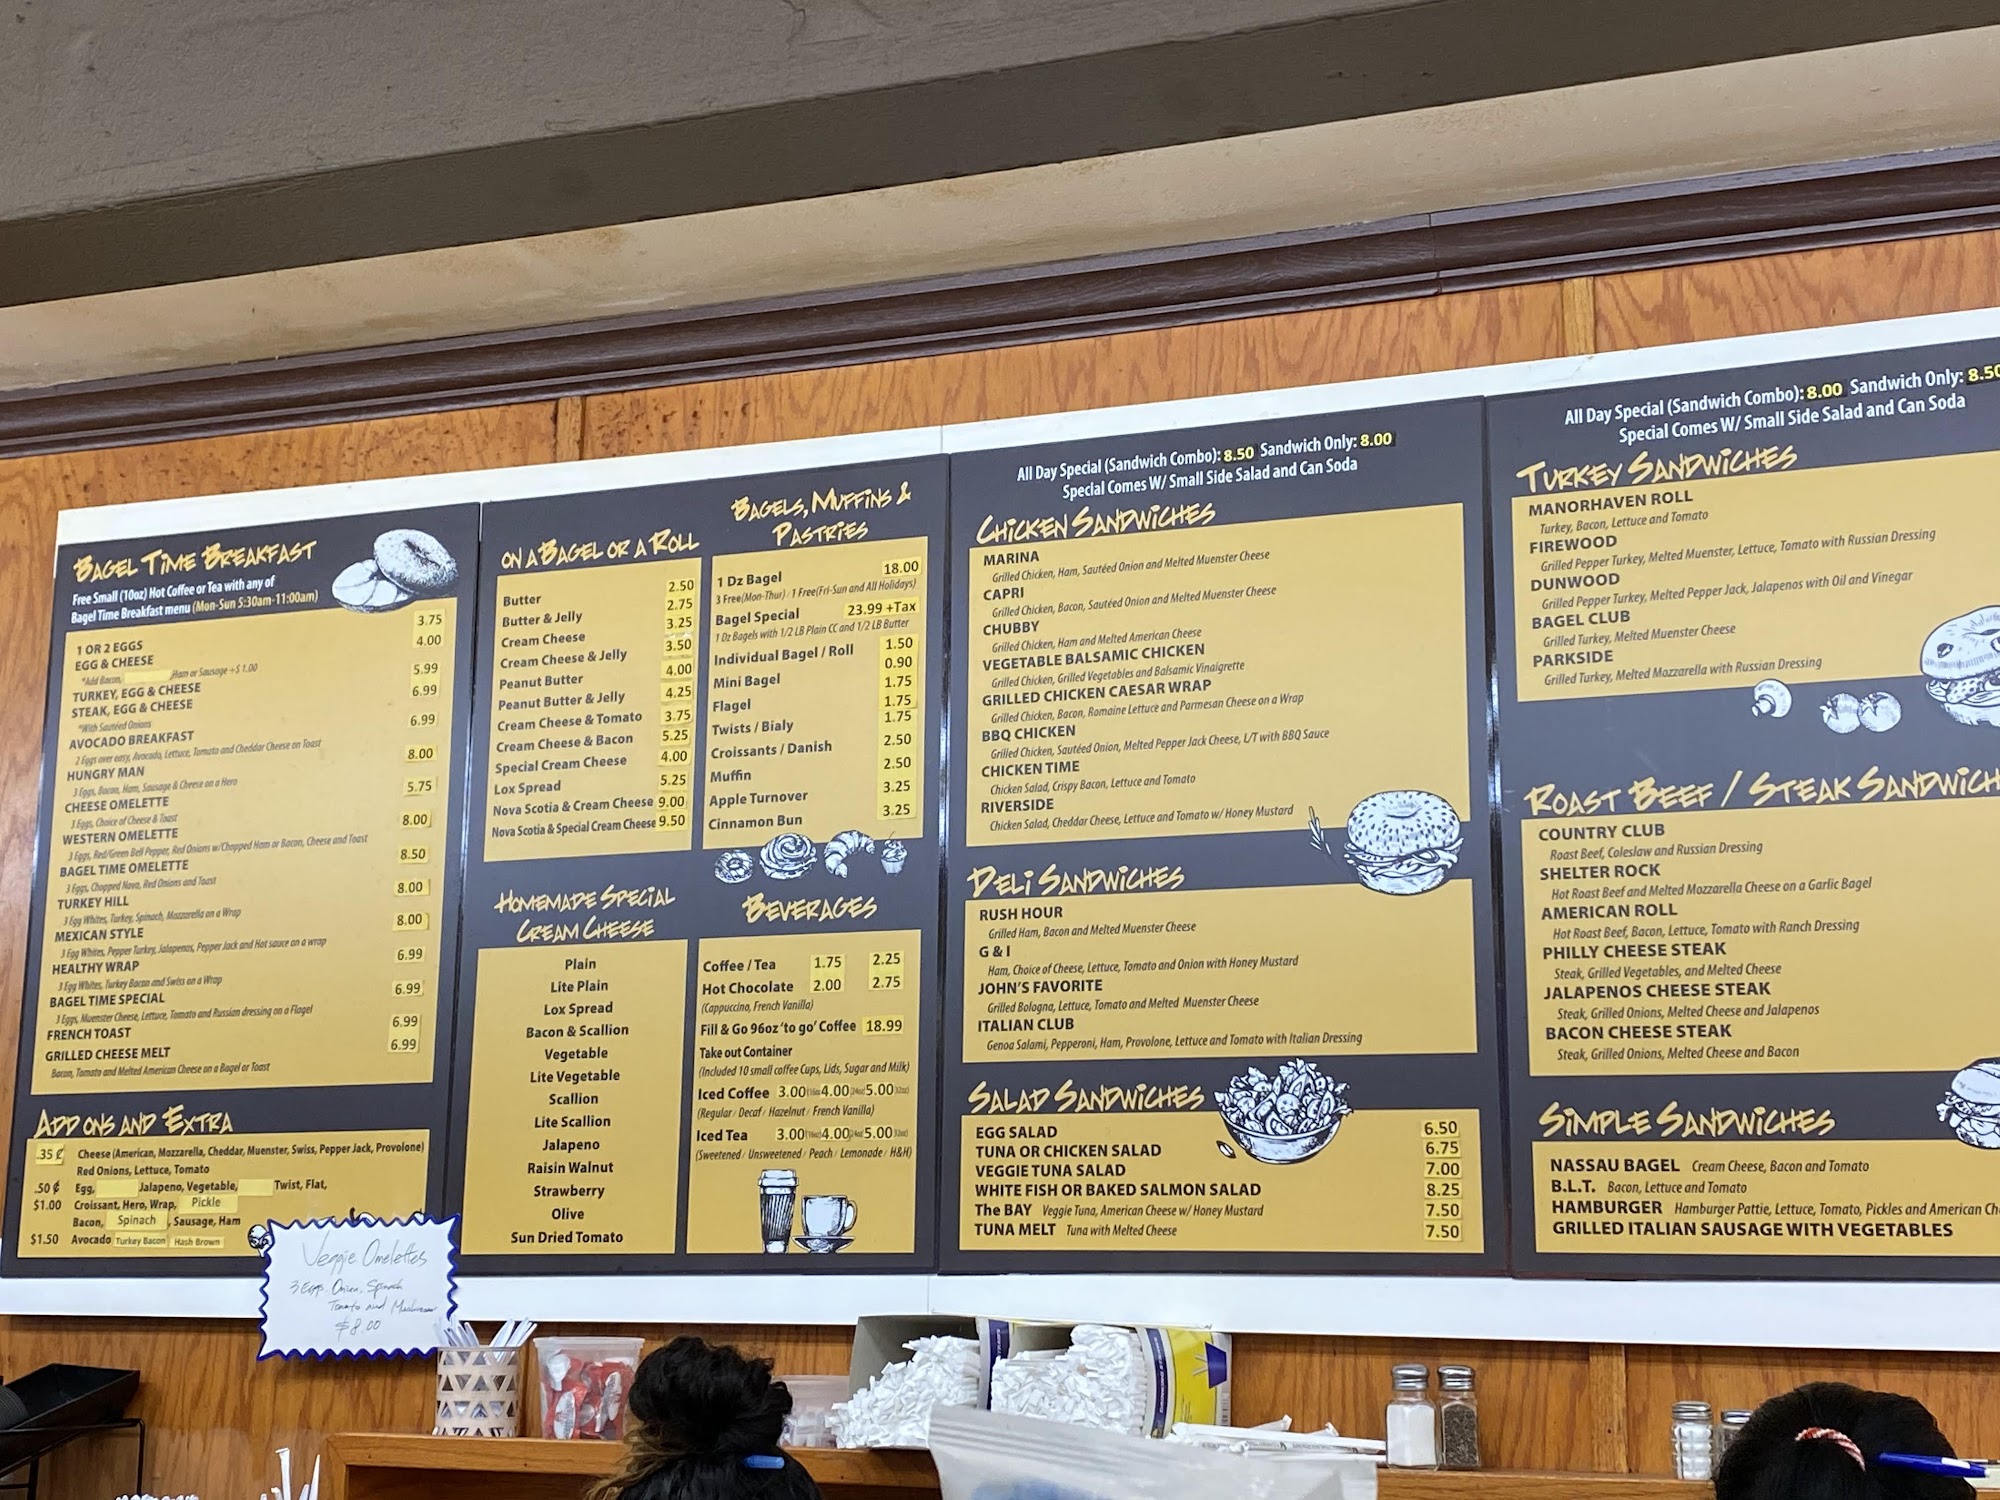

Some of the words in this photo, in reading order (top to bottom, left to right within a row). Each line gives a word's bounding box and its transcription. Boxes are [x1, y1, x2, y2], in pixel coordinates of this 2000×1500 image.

[1061, 479, 1105, 502] Special
[1107, 478, 1147, 494] Comes
[1148, 473, 1167, 490] W/
[1168, 470, 1204, 489] Small
[1205, 468, 1233, 485] Side
[1234, 464, 1270, 482] Salad
[1272, 462, 1297, 478] and
[1299, 461, 1323, 476] Can
[1325, 457, 1358, 473] Soda
[1528, 493, 1647, 517] MANORHAVEN
[1650, 489, 1693, 506] ROLL
[1539, 520, 1574, 535] Turkey,
[1575, 519, 1609, 532] Bacon,
[1610, 516, 1648, 528] Lettuce
[1648, 510, 1670, 525] and
[1670, 509, 1709, 523] Tomato
[982, 549, 1040, 567] MARINA
[884, 560, 920, 576] 18.00
[667, 578, 694, 593] 2.50
[716, 576, 723, 588] 1
[726, 575, 744, 587] Dz
[746, 570, 782, 587] Bagel
[1530, 572, 1620, 592] DUNWOOD
[417, 613, 442, 626] 3.75
[501, 615, 541, 628] Butter
[542, 612, 553, 624] &
[553, 609, 583, 624] Jelly
[715, 632, 720, 643] 1
[720, 631, 732, 643] Dz
[731, 628, 759, 644] Bagels
[759, 627, 778, 639] with
[779, 625, 794, 638] 1/2
[793, 624, 805, 637] LB
[804, 623, 827, 636] Plain
[827, 621, 839, 634] CC
[838, 620, 856, 633] and
[856, 619, 871, 632] 1/2
[870, 618, 883, 631] LB
[882, 618, 910, 630] Butter
[76, 644, 82, 656] 1
[84, 643, 102, 655] OR
[103, 642, 111, 654] 2
[112, 639, 143, 653] EGGS
[415, 633, 442, 646] 4.00
[500, 636, 540, 648] Cream
[541, 631, 586, 645] Cheese
[74, 658, 98, 672] EGG
[99, 657, 109, 670] &
[110, 653, 154, 669] CHEESE
[1532, 649, 1614, 668] PARKSIDE
[68, 734, 126, 750] AVOCADO
[127, 729, 195, 746] BREAKFAST
[709, 768, 752, 783] Muffin
[989, 782, 1023, 796] Chicken
[1023, 780, 1050, 794] Salad,
[1051, 779, 1079, 794] Crispy
[1078, 778, 1109, 790] Bacon,
[1109, 776, 1143, 789] Lettuce
[1142, 773, 1162, 786] and
[1162, 773, 1196, 785] Tomato
[979, 907, 1018, 921] RUSH
[1020, 905, 1063, 920] HOUR
[872, 951, 901, 966] 2.25
[1542, 944, 1599, 960] PHILLY
[1602, 942, 1667, 958] CHEESE
[1670, 941, 1727, 957] STEAK
[702, 958, 744, 973] Coffee
[746, 958, 752, 972] /
[753, 957, 776, 971] Tea
[813, 955, 842, 969] 1.75
[1553, 966, 1585, 981] Steak,
[1586, 965, 1622, 979] Grilled
[1622, 964, 1682, 981] Vegetables,
[1683, 963, 1706, 977] and
[1705, 961, 1744, 976] Melted
[1744, 961, 1782, 976] Cheese
[700, 1000, 752, 1016] (Cappuccino,
[752, 999, 781, 1012] French
[782, 998, 814, 1011] Vanilla)
[392, 1014, 418, 1028] 6.99
[865, 1018, 903, 1033] 18.99
[525, 1026, 564, 1039] Bacon
[566, 1024, 577, 1037] &
[578, 1023, 629, 1037] Scallion
[44, 1048, 93, 1062] GRILLED
[94, 1047, 139, 1060] CHEESE
[140, 1045, 171, 1059] MELT
[76, 1148, 111, 1159] Cheese
[111, 1146, 156, 1160] (American,
[157, 1145, 206, 1158] Mozzarella,
[206, 1144, 246, 1157] Cheddar,
[246, 1144, 290, 1156] Muenster,
[290, 1143, 318, 1156] Swiss,
[318, 1143, 351, 1157] Pepper
[350, 1142, 374, 1155] Jack,
[375, 1141, 425, 1154] Provolone)
[1549, 1157, 1620, 1172] NASSAU
[1623, 1157, 1681, 1172] BAGEL
[1691, 1159, 1726, 1172] Cream
[1726, 1159, 1767, 1174] Cheese,
[1769, 1158, 1803, 1173] Bacon
[1804, 1158, 1827, 1172] and
[1828, 1158, 1870, 1172] Tomato
[533, 1183, 605, 1200] Strawberry
[974, 1183, 1022, 1197] WHITE
[1024, 1183, 1058, 1197] FISH
[1060, 1183, 1083, 1197] OR
[1085, 1183, 1137, 1197] BAKED
[1139, 1182, 1206, 1196] SALMON
[1209, 1182, 1262, 1197] SALAD
[1426, 1183, 1460, 1197] 8.25
[32, 1198, 62, 1212] $1.00
[73, 1199, 121, 1211] Croissant,
[121, 1198, 148, 1211] Hero,
[148, 1198, 177, 1213] Wrap,
[190, 1195, 221, 1208] Pickle
[973, 1203, 1001, 1216] The
[1003, 1203, 1033, 1216] BAY
[1042, 1204, 1073, 1219] Veggie
[1073, 1204, 1099, 1218] Tuna,
[1099, 1204, 1144, 1217] American
[1144, 1204, 1177, 1217] Cheese
[1177, 1204, 1193, 1217] w/
[1192, 1204, 1223, 1219] Honey
[1223, 1204, 1264, 1217] Mustard
[116, 1213, 157, 1228] Spinach
[1551, 1220, 1624, 1235] GRILLED
[1627, 1221, 1696, 1236] ITALIAN
[1700, 1221, 1784, 1236] SAUSAGE
[1785, 1221, 1834, 1237] WITH
[1836, 1221, 1953, 1237] VEGETABLES
